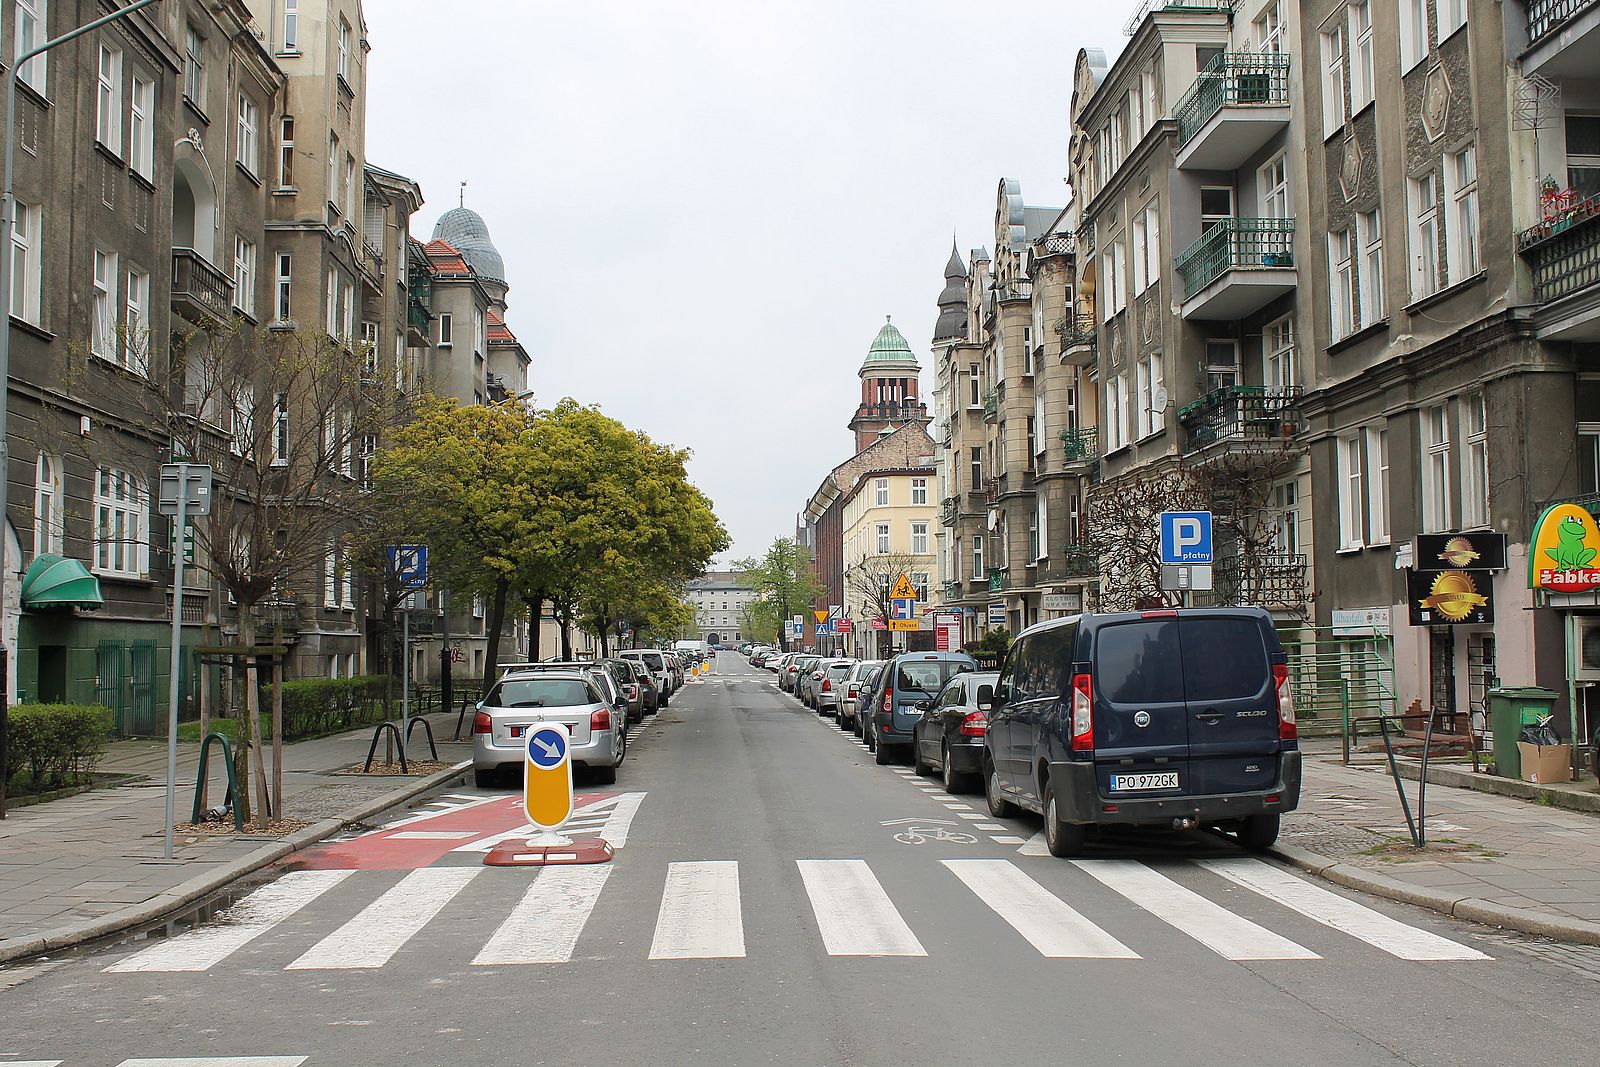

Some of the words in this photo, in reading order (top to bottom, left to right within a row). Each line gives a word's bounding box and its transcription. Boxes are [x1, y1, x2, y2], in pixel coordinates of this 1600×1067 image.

[1172, 517, 1202, 557] P
[1183, 552, 1211, 560] płatny
[1541, 570, 1600, 584] żabka
[1236, 710, 1267, 718] SCUDO
[1137, 716, 1149, 724] FIAT
[1117, 777, 1136, 788] PO
[1140, 774, 1177, 788] 972GK
